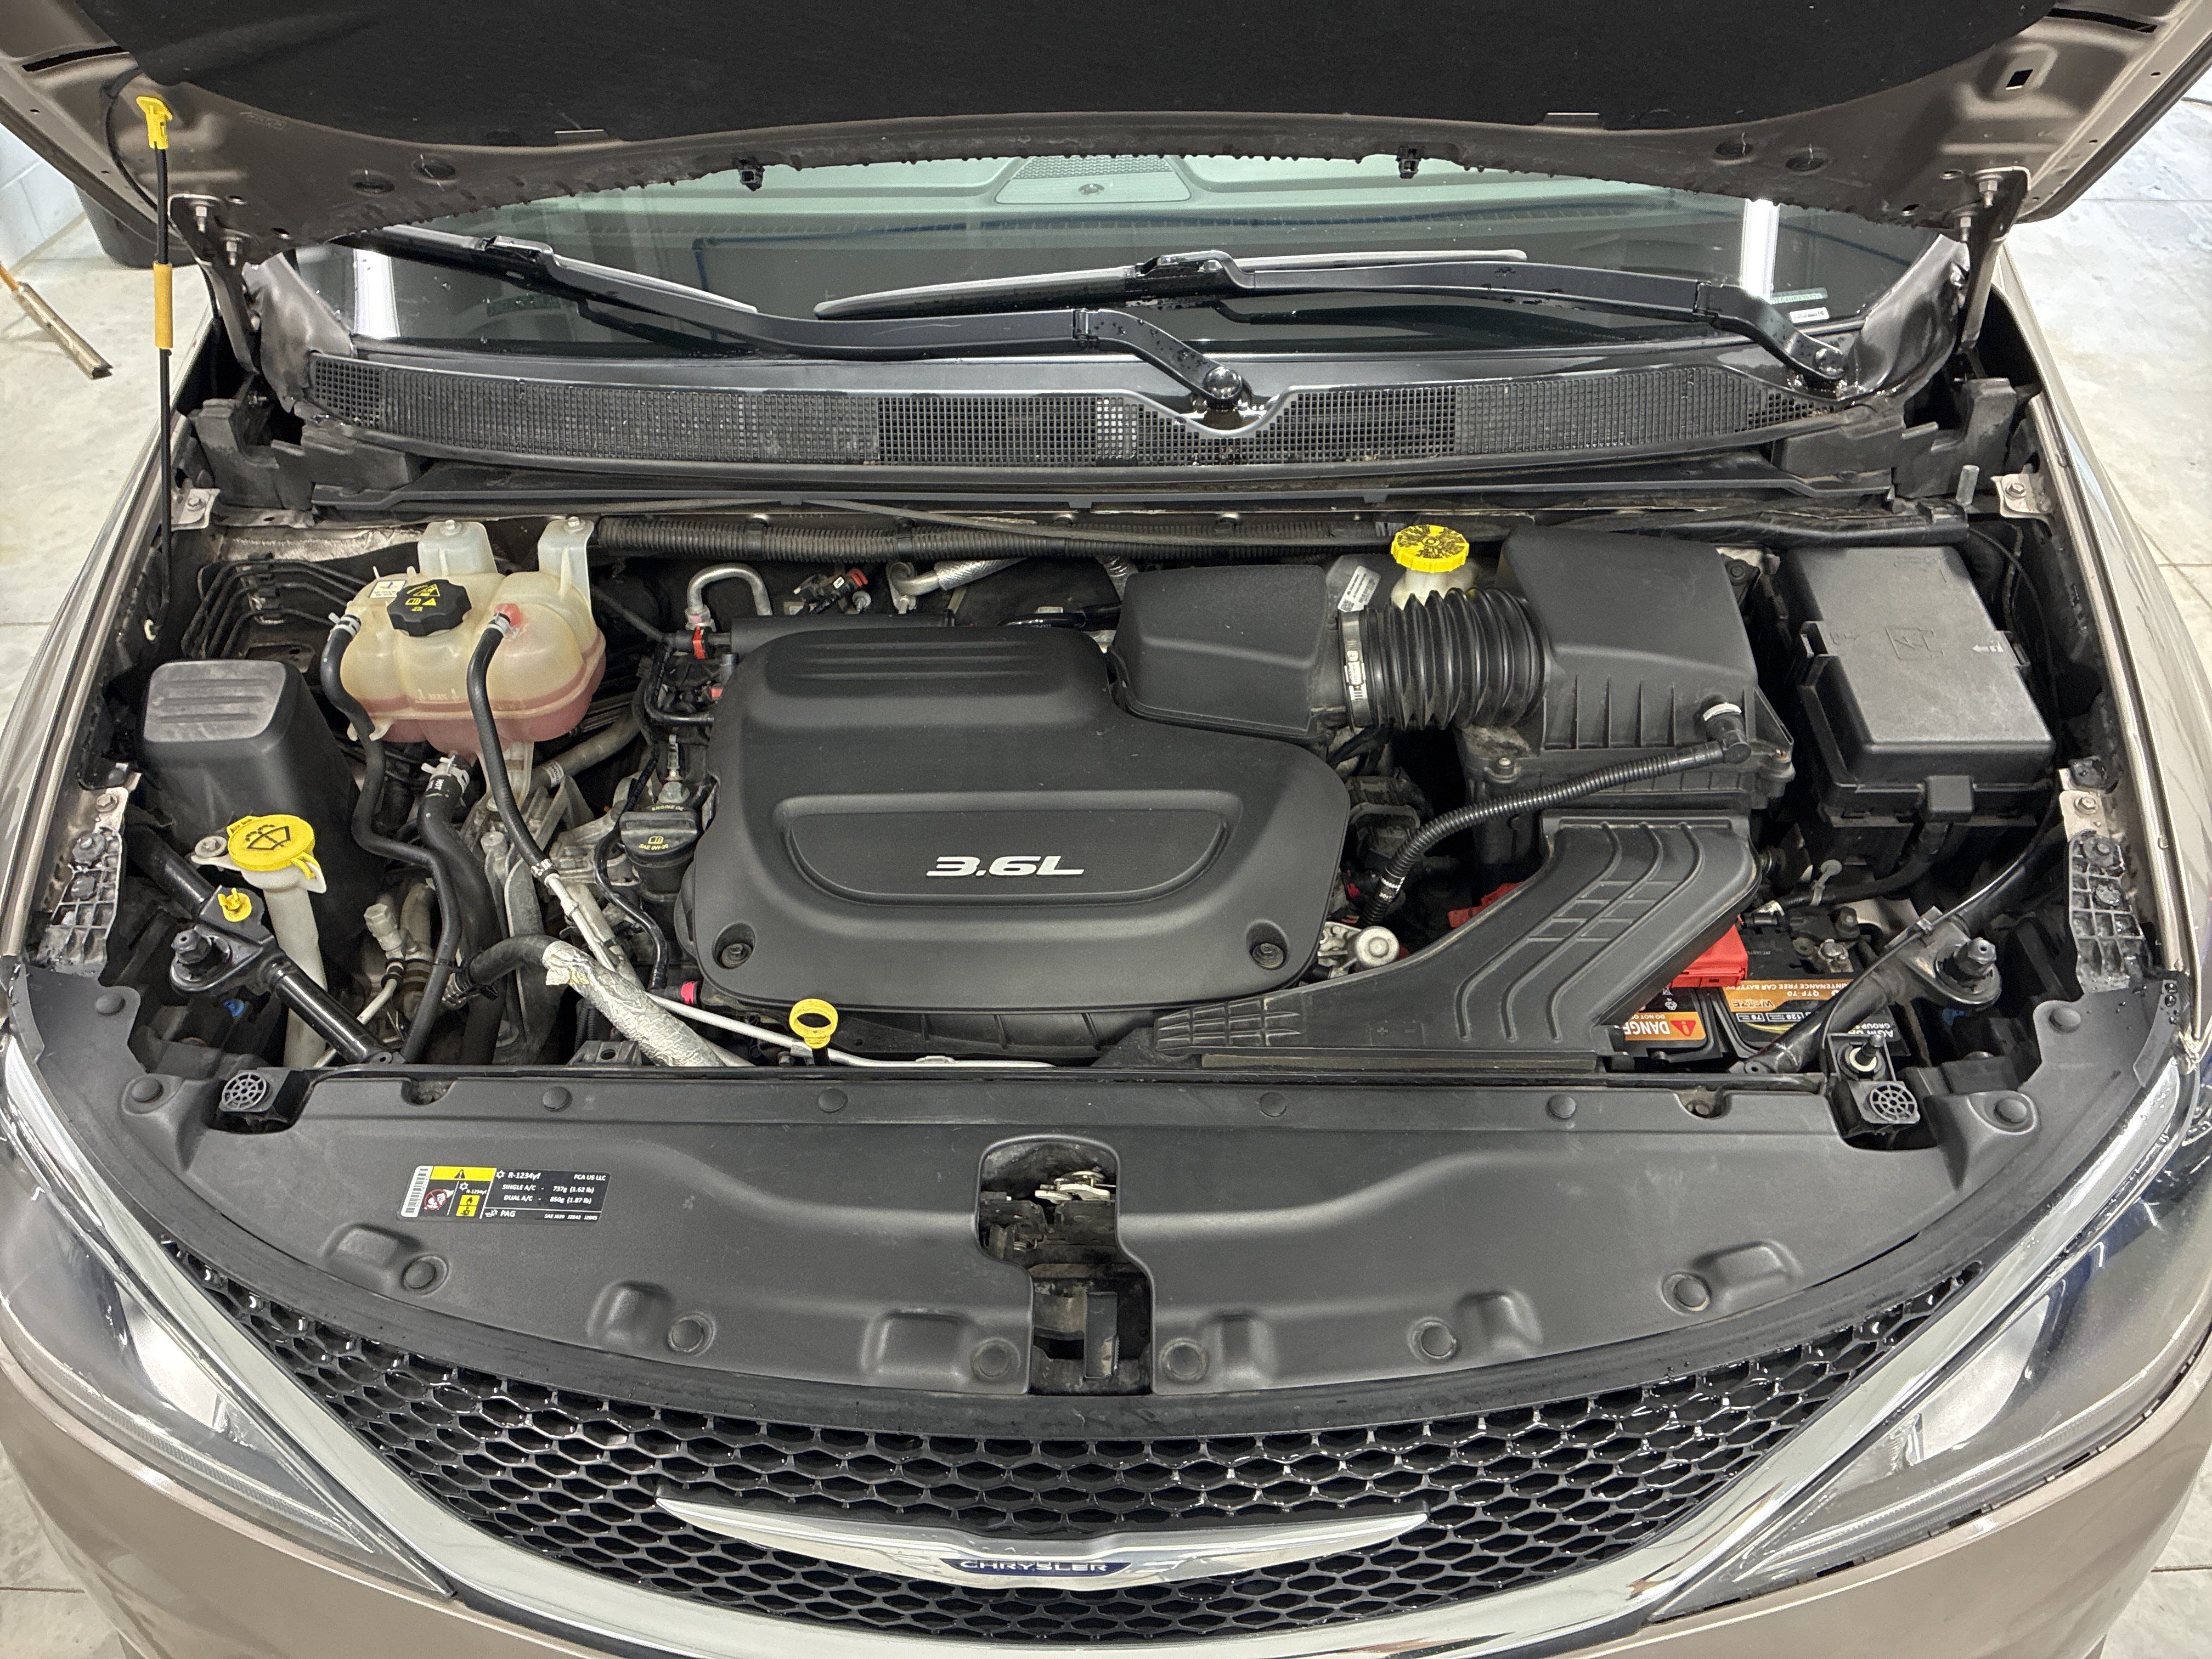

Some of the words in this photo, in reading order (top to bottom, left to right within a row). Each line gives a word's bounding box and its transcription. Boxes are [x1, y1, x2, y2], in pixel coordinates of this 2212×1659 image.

[926, 855, 1085, 877] 3.6L
[1623, 1021, 1671, 1035] DANGE
[507, 1172, 541, 1181] R-1234yf
[960, 1561, 1107, 1571] CHRYSLER
